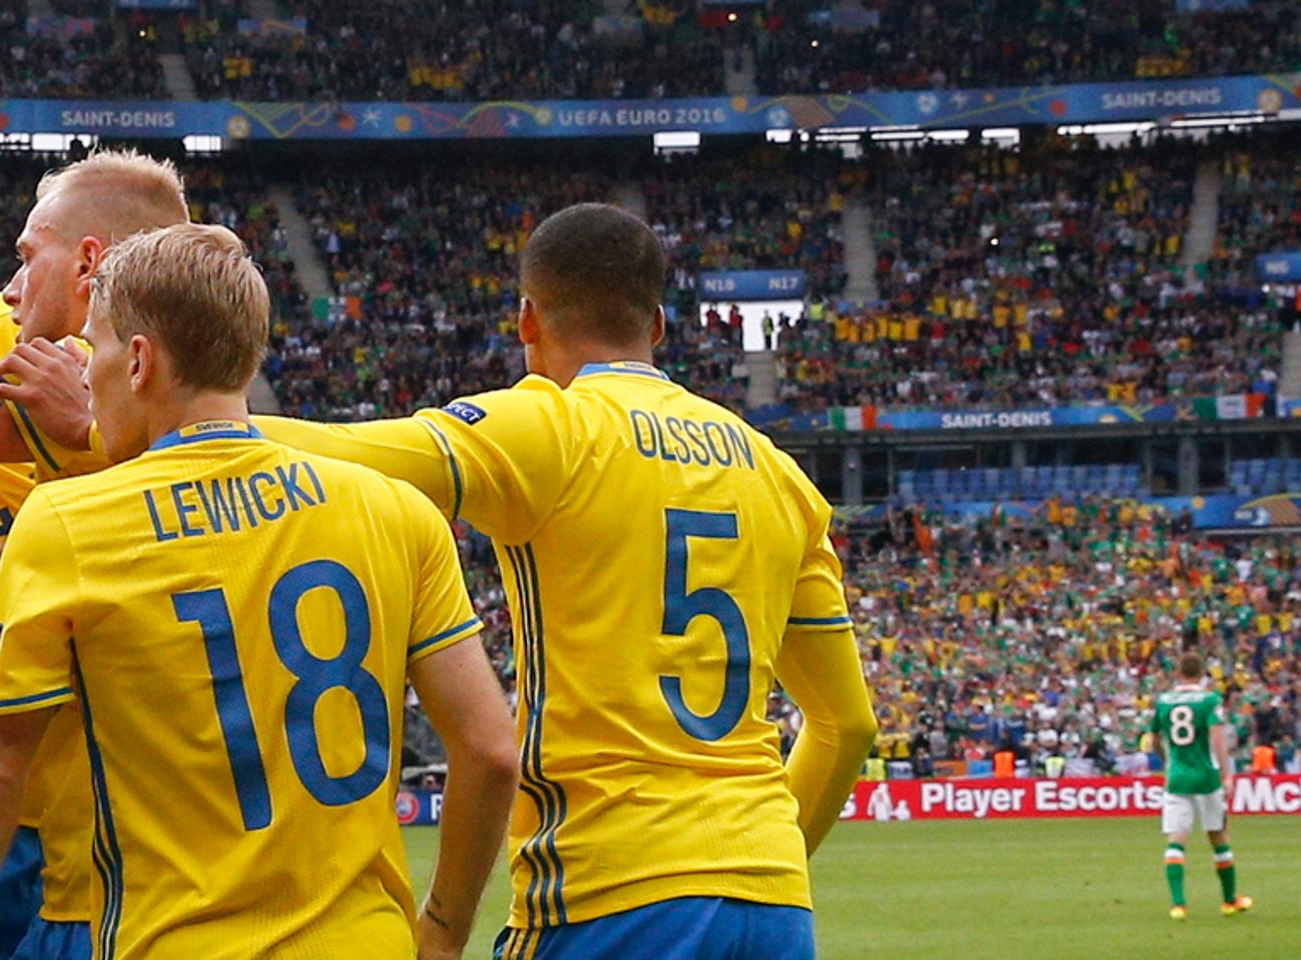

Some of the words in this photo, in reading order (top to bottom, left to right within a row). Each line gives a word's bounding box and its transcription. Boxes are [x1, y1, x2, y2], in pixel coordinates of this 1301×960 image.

[558, 110, 612, 127] UEFA
[616, 109, 672, 126] EURO
[675, 107, 727, 125] 2016
[1101, 87, 1222, 110] SAINT-DENIS
[61, 110, 176, 128] SAINT-DENIS
[631, 408, 758, 470] OLSSON
[941, 411, 1052, 429] SAINT-DENIS
[143, 461, 327, 542] LEWICKI
[659, 507, 751, 742] 5
[170, 559, 391, 831] 18
[1169, 705, 1196, 746] 8
[920, 781, 1026, 819] Player
[1034, 780, 1165, 811] Escorts
